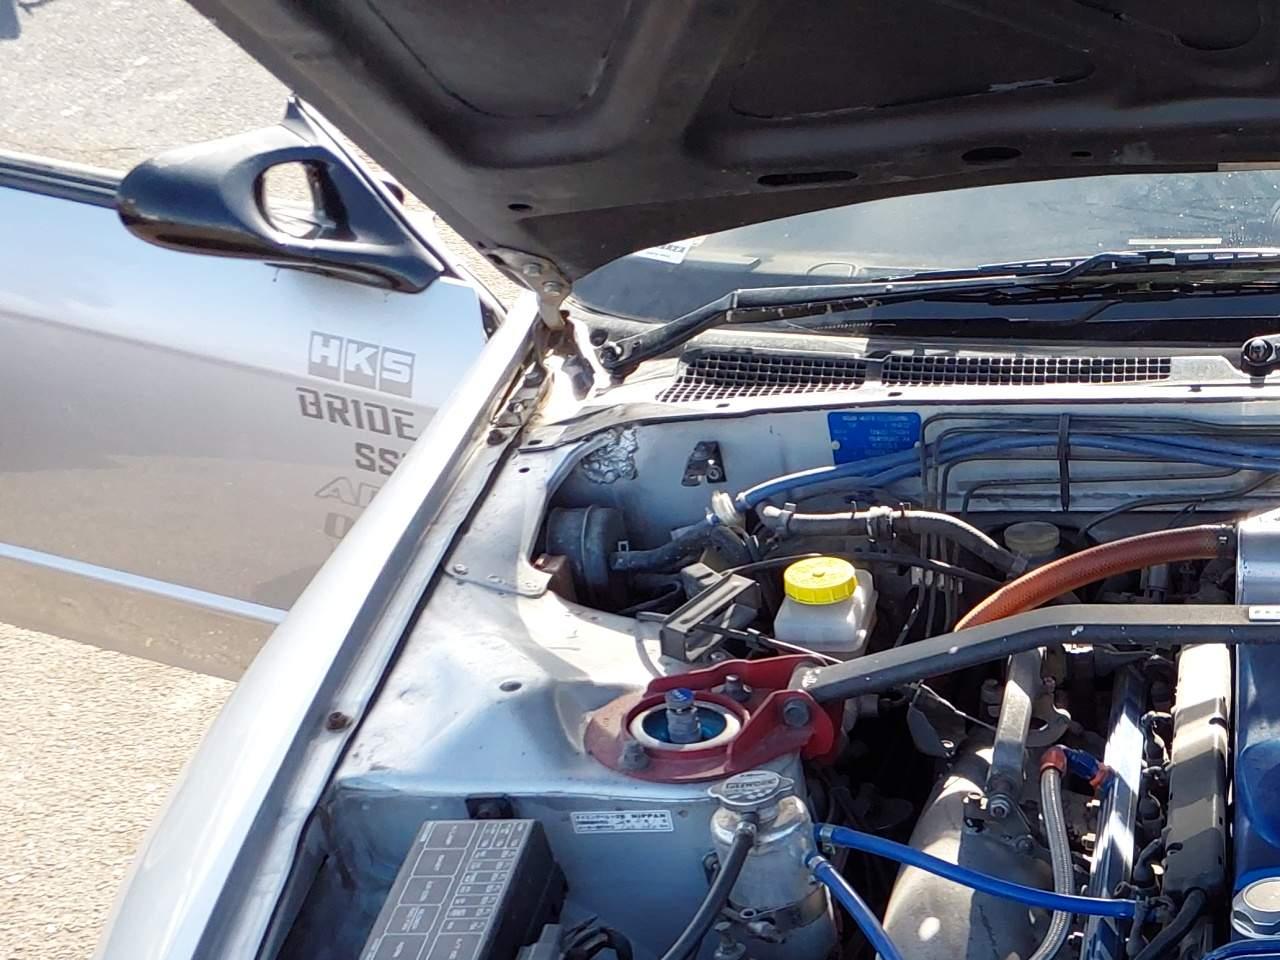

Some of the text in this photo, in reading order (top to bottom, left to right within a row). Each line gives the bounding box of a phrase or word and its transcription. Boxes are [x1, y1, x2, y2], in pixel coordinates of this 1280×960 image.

[309, 332, 415, 389] HKS
[296, 387, 418, 441] BRIDE
[355, 442, 407, 476] SS
